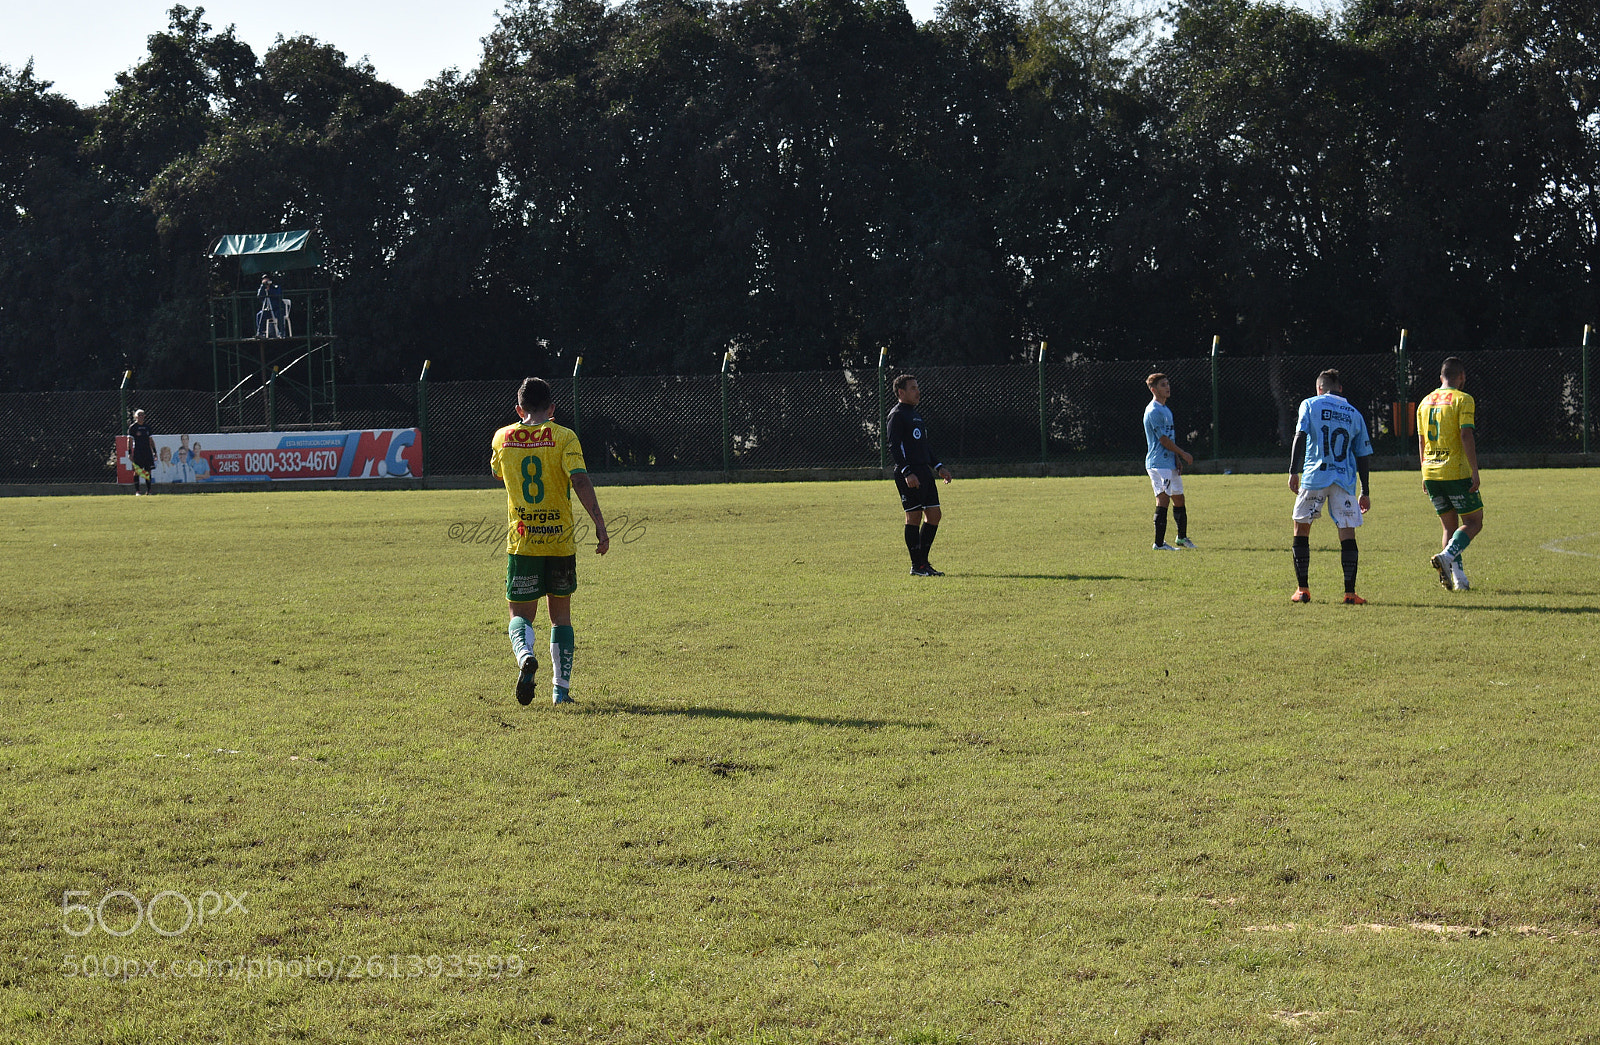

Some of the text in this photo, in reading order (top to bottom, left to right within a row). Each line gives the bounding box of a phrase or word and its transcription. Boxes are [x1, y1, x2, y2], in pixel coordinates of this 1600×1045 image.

[505, 427, 553, 442] ROCA
[1428, 408, 1441, 441] 5
[1321, 425, 1349, 462] 10
[218, 461, 240, 472] 24HS
[244, 450, 337, 472] 0800-333-4670
[521, 455, 545, 504] 8
